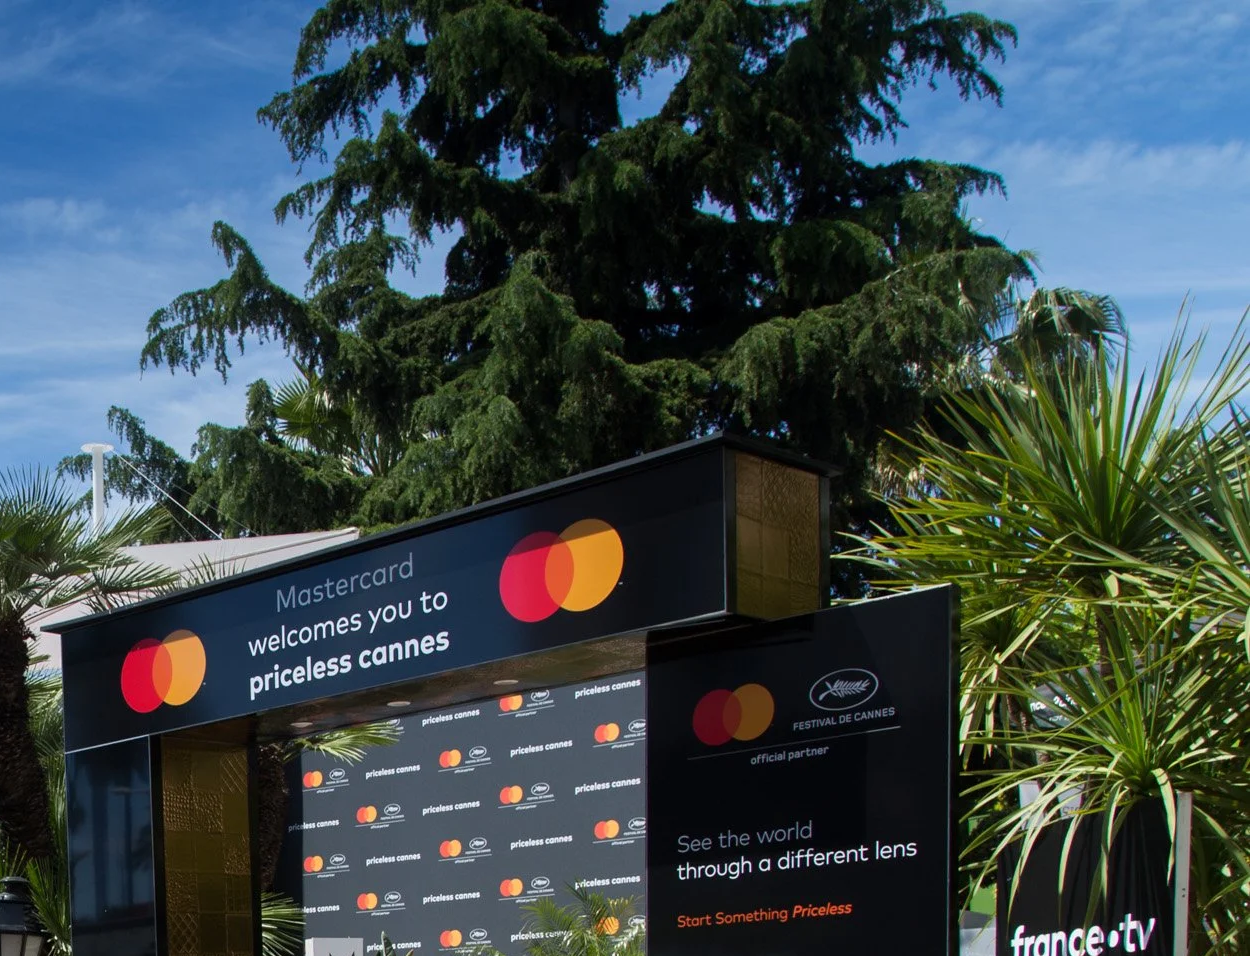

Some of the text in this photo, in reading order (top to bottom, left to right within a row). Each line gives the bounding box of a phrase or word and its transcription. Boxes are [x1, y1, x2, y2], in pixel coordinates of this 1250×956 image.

[276, 551, 414, 613] Mastercard
[248, 590, 449, 657] welcomes you to
[250, 630, 450, 701] priceless cannes
[574, 678, 641, 700] priceless cannes
[421, 708, 480, 727] priceless cannes
[793, 706, 896, 732] FESTIVAL DE CANNES
[510, 739, 573, 758] priceless cannes
[750, 745, 830, 765] official partner
[365, 763, 421, 780] priceless cannes
[574, 777, 641, 795] priceless cannes
[422, 800, 480, 816] priceless cannes
[316, 819, 340, 829] cannes
[510, 834, 573, 850] priceless cannes
[677, 819, 813, 854] See the world
[366, 852, 421, 867] priceless cannes
[676, 840, 918, 881] through a different lens
[611, 874, 641, 885] cannes
[422, 891, 481, 905] priceless cannes
[317, 904, 340, 913] cannes
[677, 902, 853, 928] Start Something Priceless
[397, 940, 422, 950] cannes
